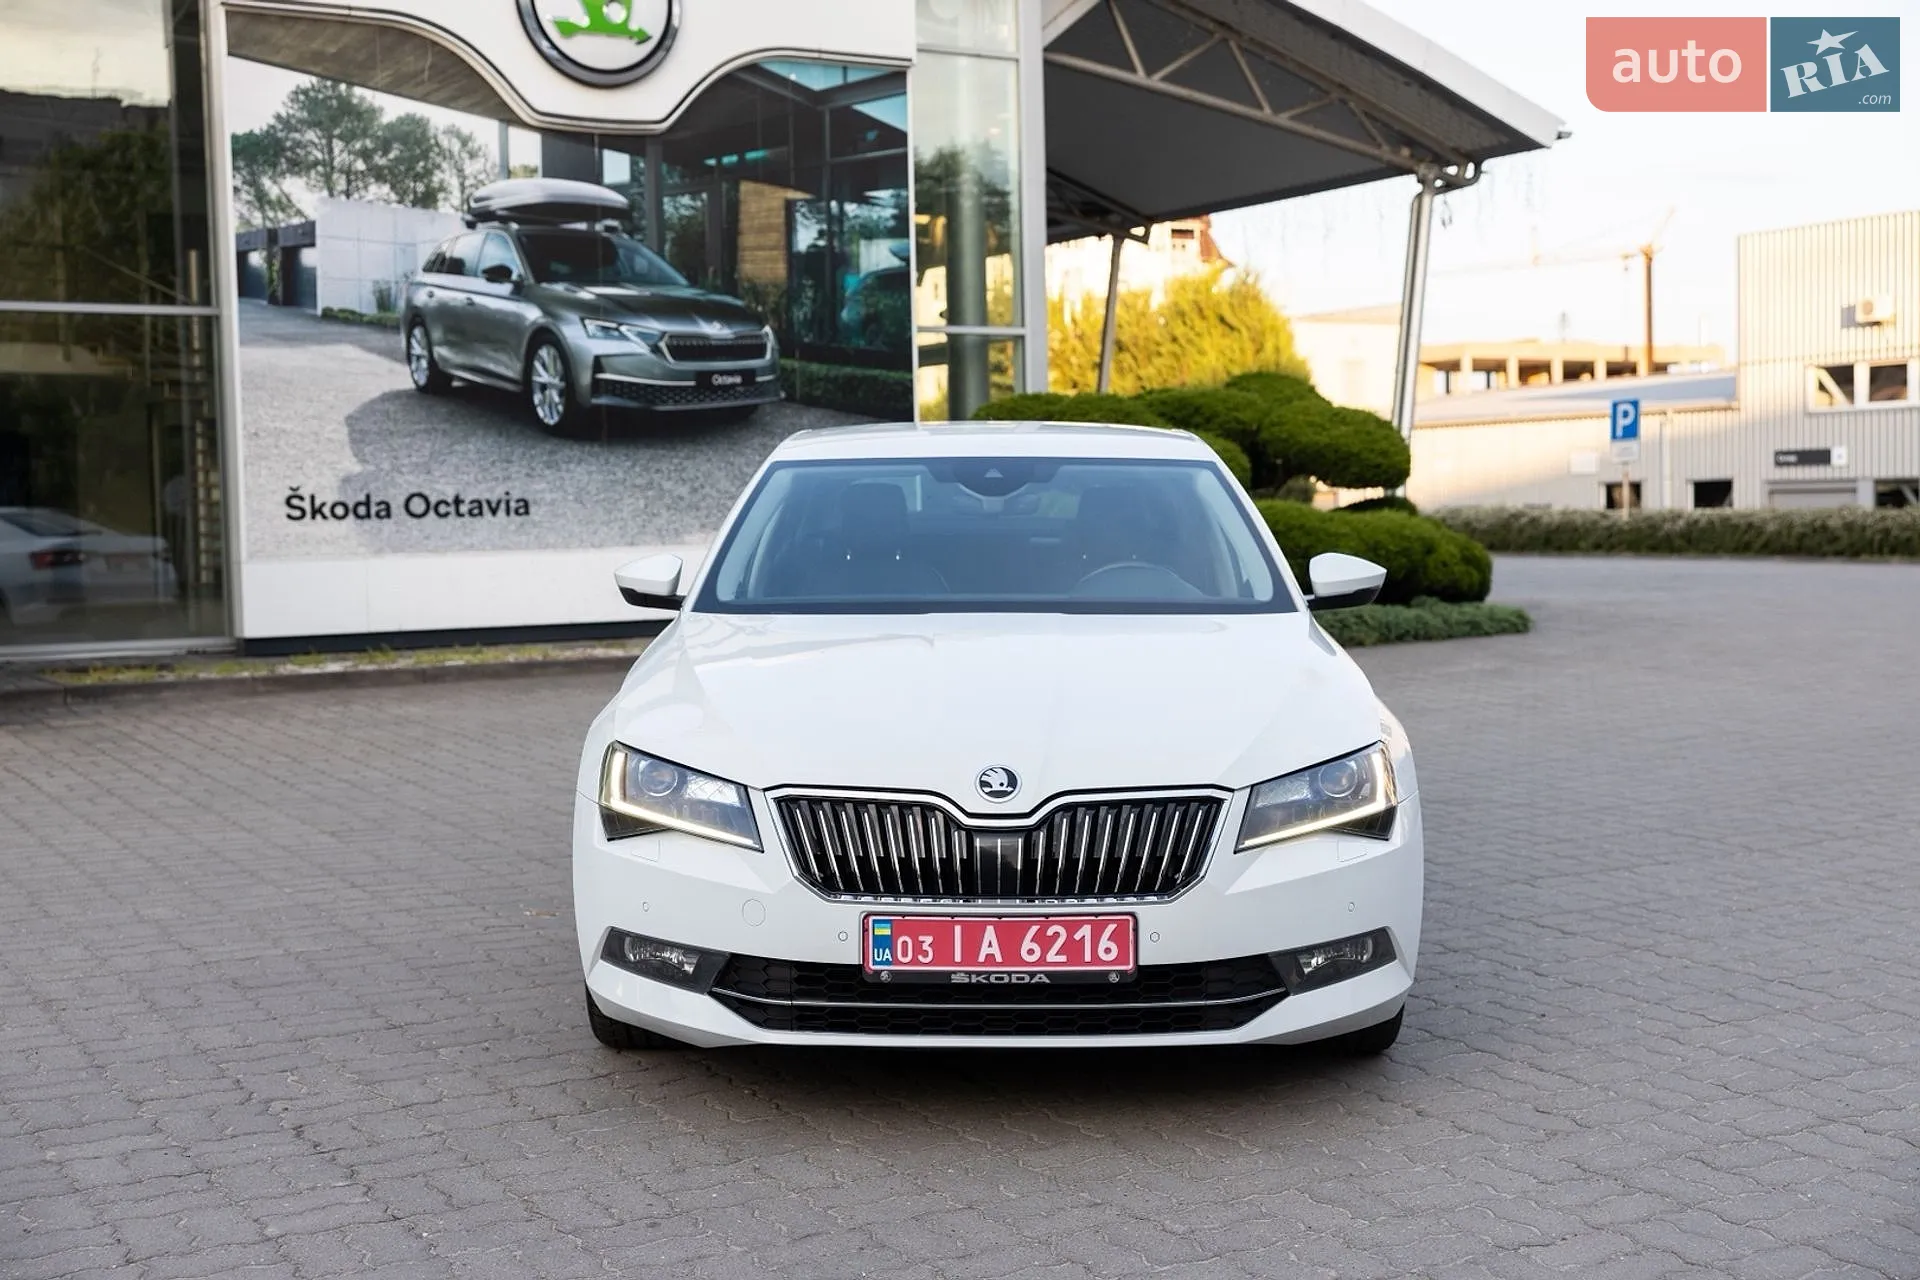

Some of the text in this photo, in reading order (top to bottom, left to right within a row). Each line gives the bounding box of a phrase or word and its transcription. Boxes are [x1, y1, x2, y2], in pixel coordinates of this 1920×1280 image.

[1616, 402, 1636, 437] P
[285, 486, 530, 521] Škoda Octavia
[874, 948, 892, 961] UA
[897, 935, 934, 963] 03
[1020, 924, 1118, 962] 6216
